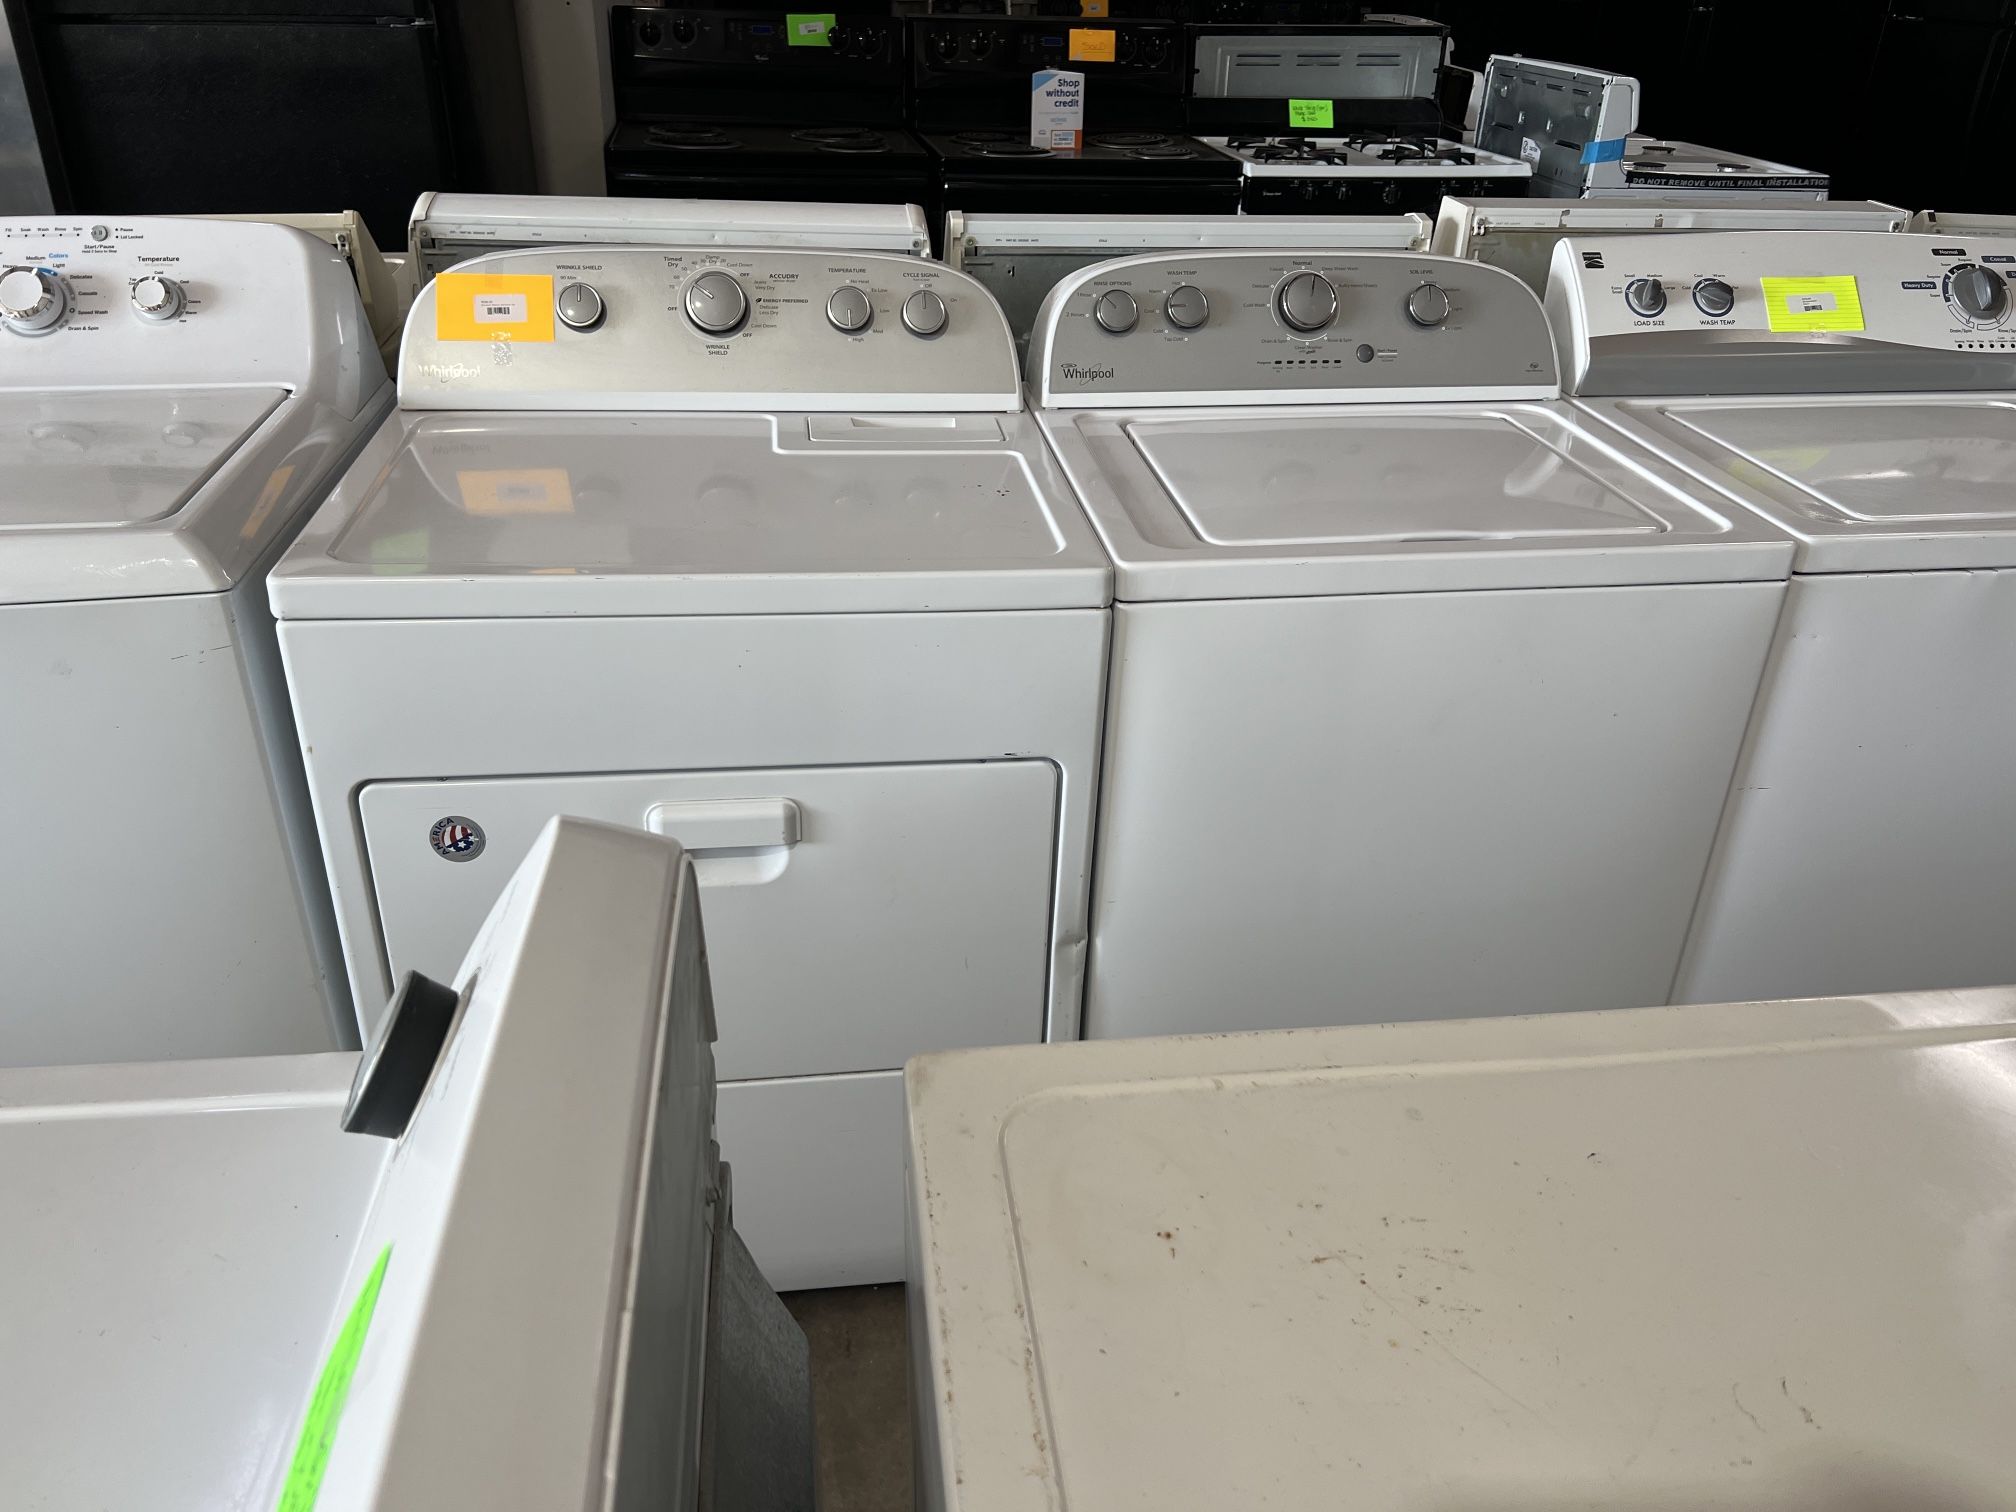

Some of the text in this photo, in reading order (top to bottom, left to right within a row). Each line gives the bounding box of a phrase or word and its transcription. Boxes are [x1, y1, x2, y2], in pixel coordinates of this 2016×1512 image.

[1058, 78, 1080, 88] Shop
[1046, 89, 1080, 98] without
[1055, 99, 1079, 107] credit
[1669, 179, 1706, 187] REMOVE
[137, 256, 180, 264] Temperature
[417, 364, 480, 380] Whirlpool
[1063, 367, 1114, 381] Whirlpool
[432, 817, 454, 855] AMERICA
